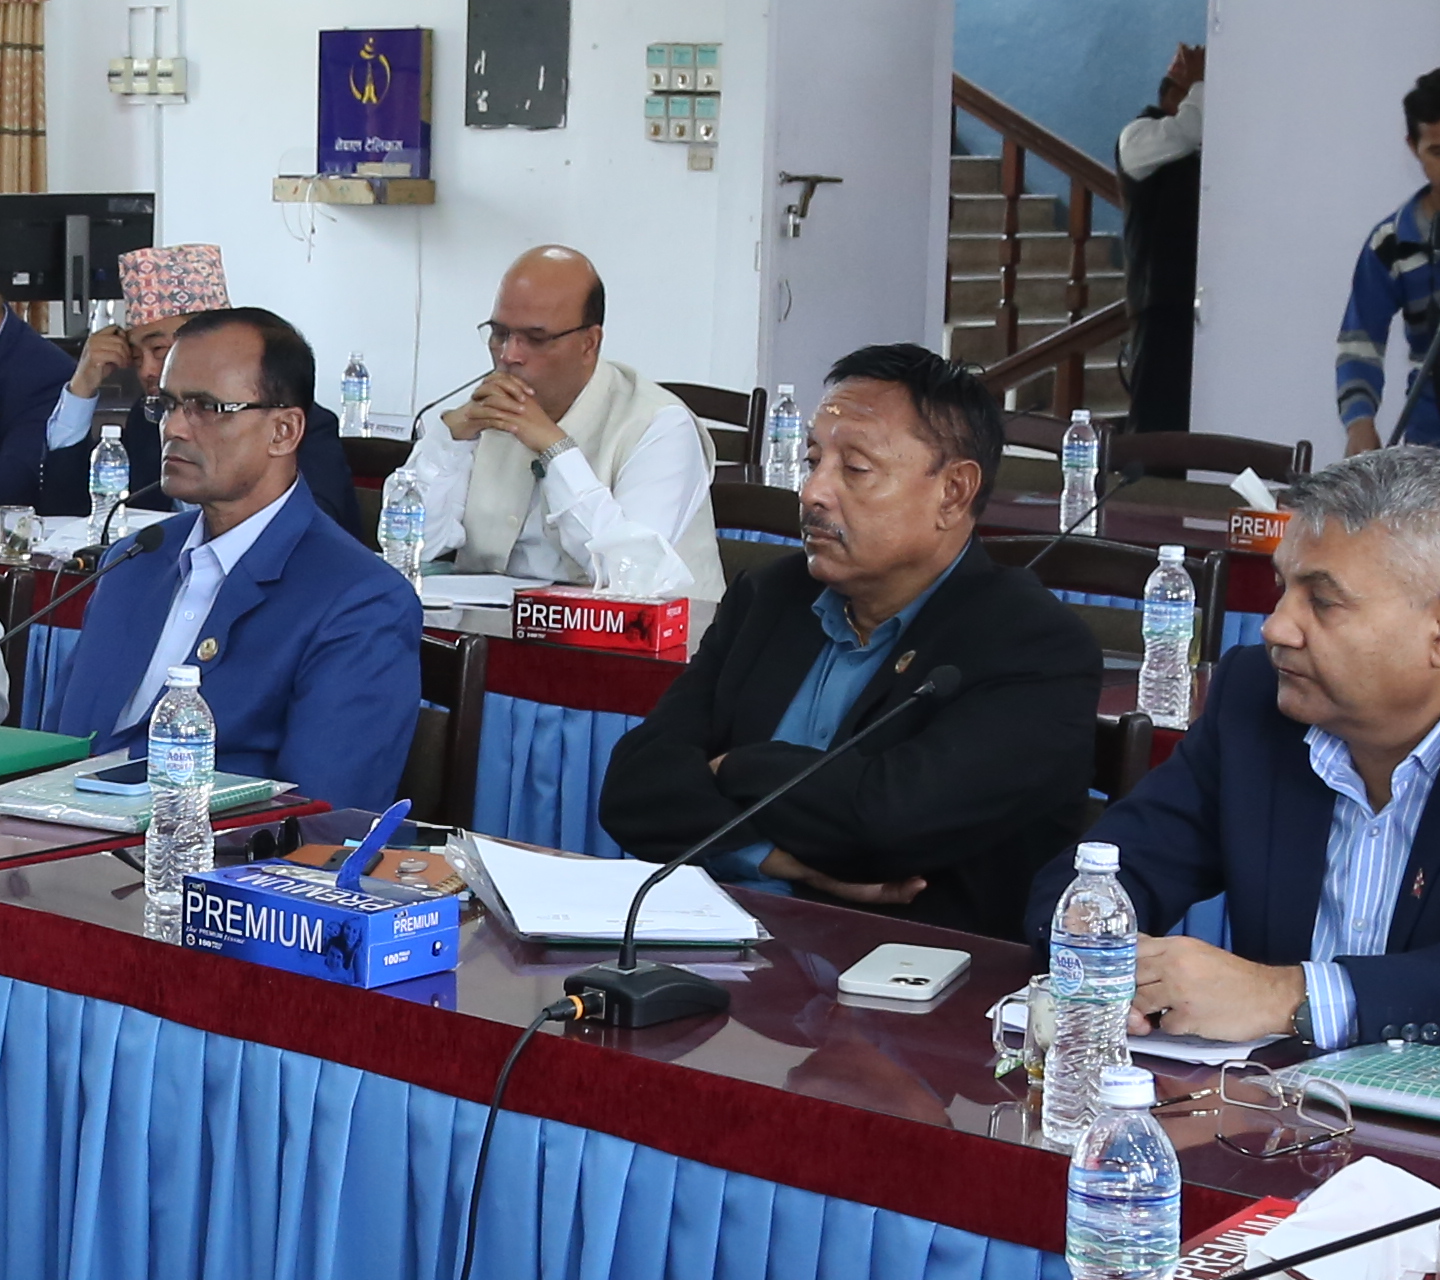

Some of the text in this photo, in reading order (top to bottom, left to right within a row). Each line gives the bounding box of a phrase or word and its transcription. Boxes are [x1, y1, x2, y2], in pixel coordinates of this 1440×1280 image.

[335, 136, 363, 152] नेपाल
[1231, 515, 1284, 538] PREMI
[517, 602, 624, 634] PREMIUM
[186, 890, 323, 954] PREMIUM
[392, 911, 439, 935] PREMIUM
[383, 953, 399, 966] 100
